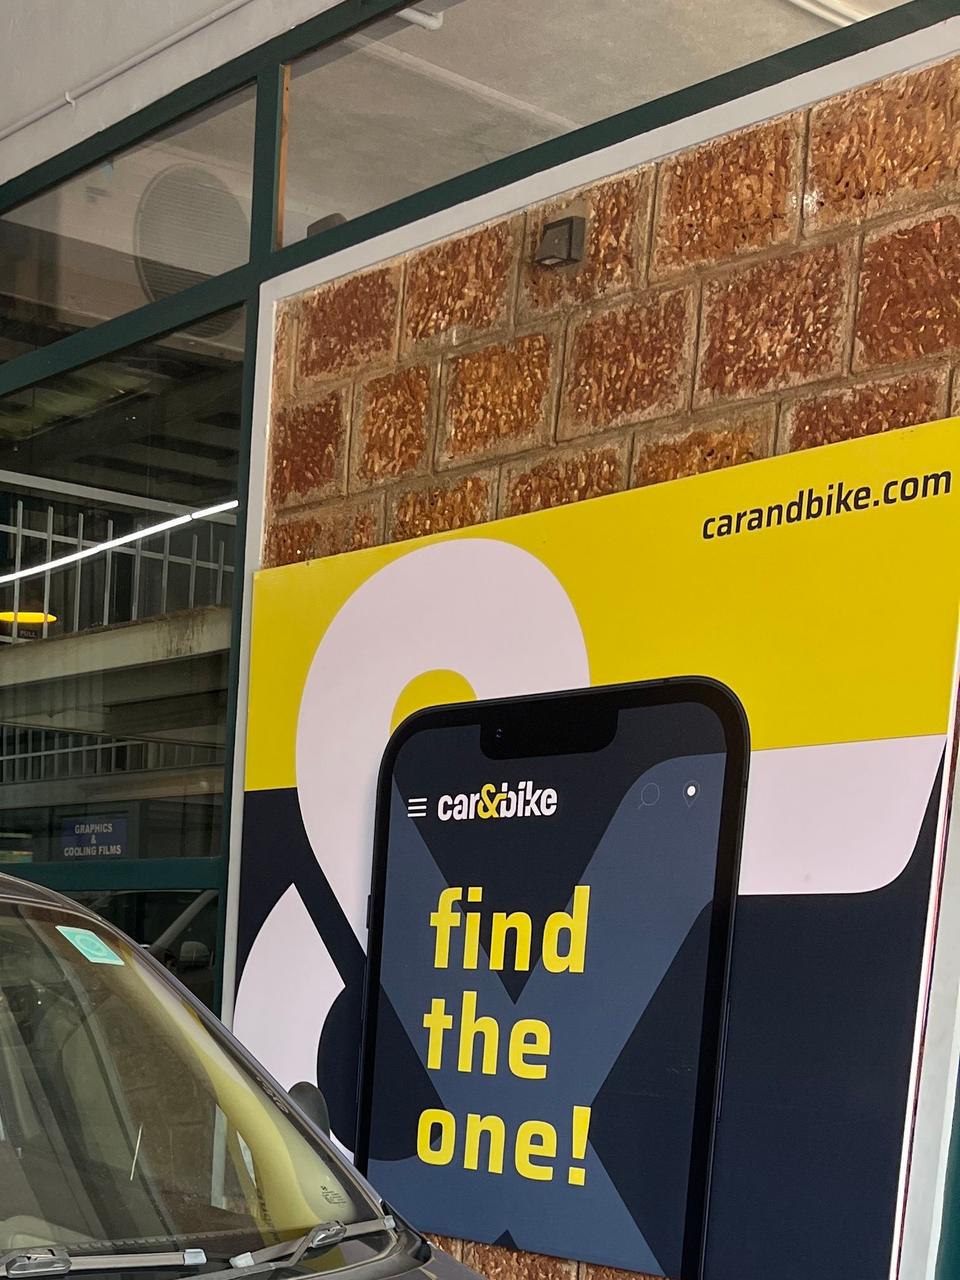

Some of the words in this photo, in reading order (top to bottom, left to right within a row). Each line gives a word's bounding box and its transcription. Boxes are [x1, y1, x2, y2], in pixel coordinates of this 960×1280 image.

[702, 470, 952, 540] carandbike.com
[74, 823, 113, 834] GRAPHICS
[437, 781, 559, 822] car&bike
[64, 846, 97, 857] COOLING
[98, 844, 121, 855] FILMS
[429, 884, 591, 973] find
[423, 990, 551, 1079] the
[416, 1105, 592, 1187] one!
